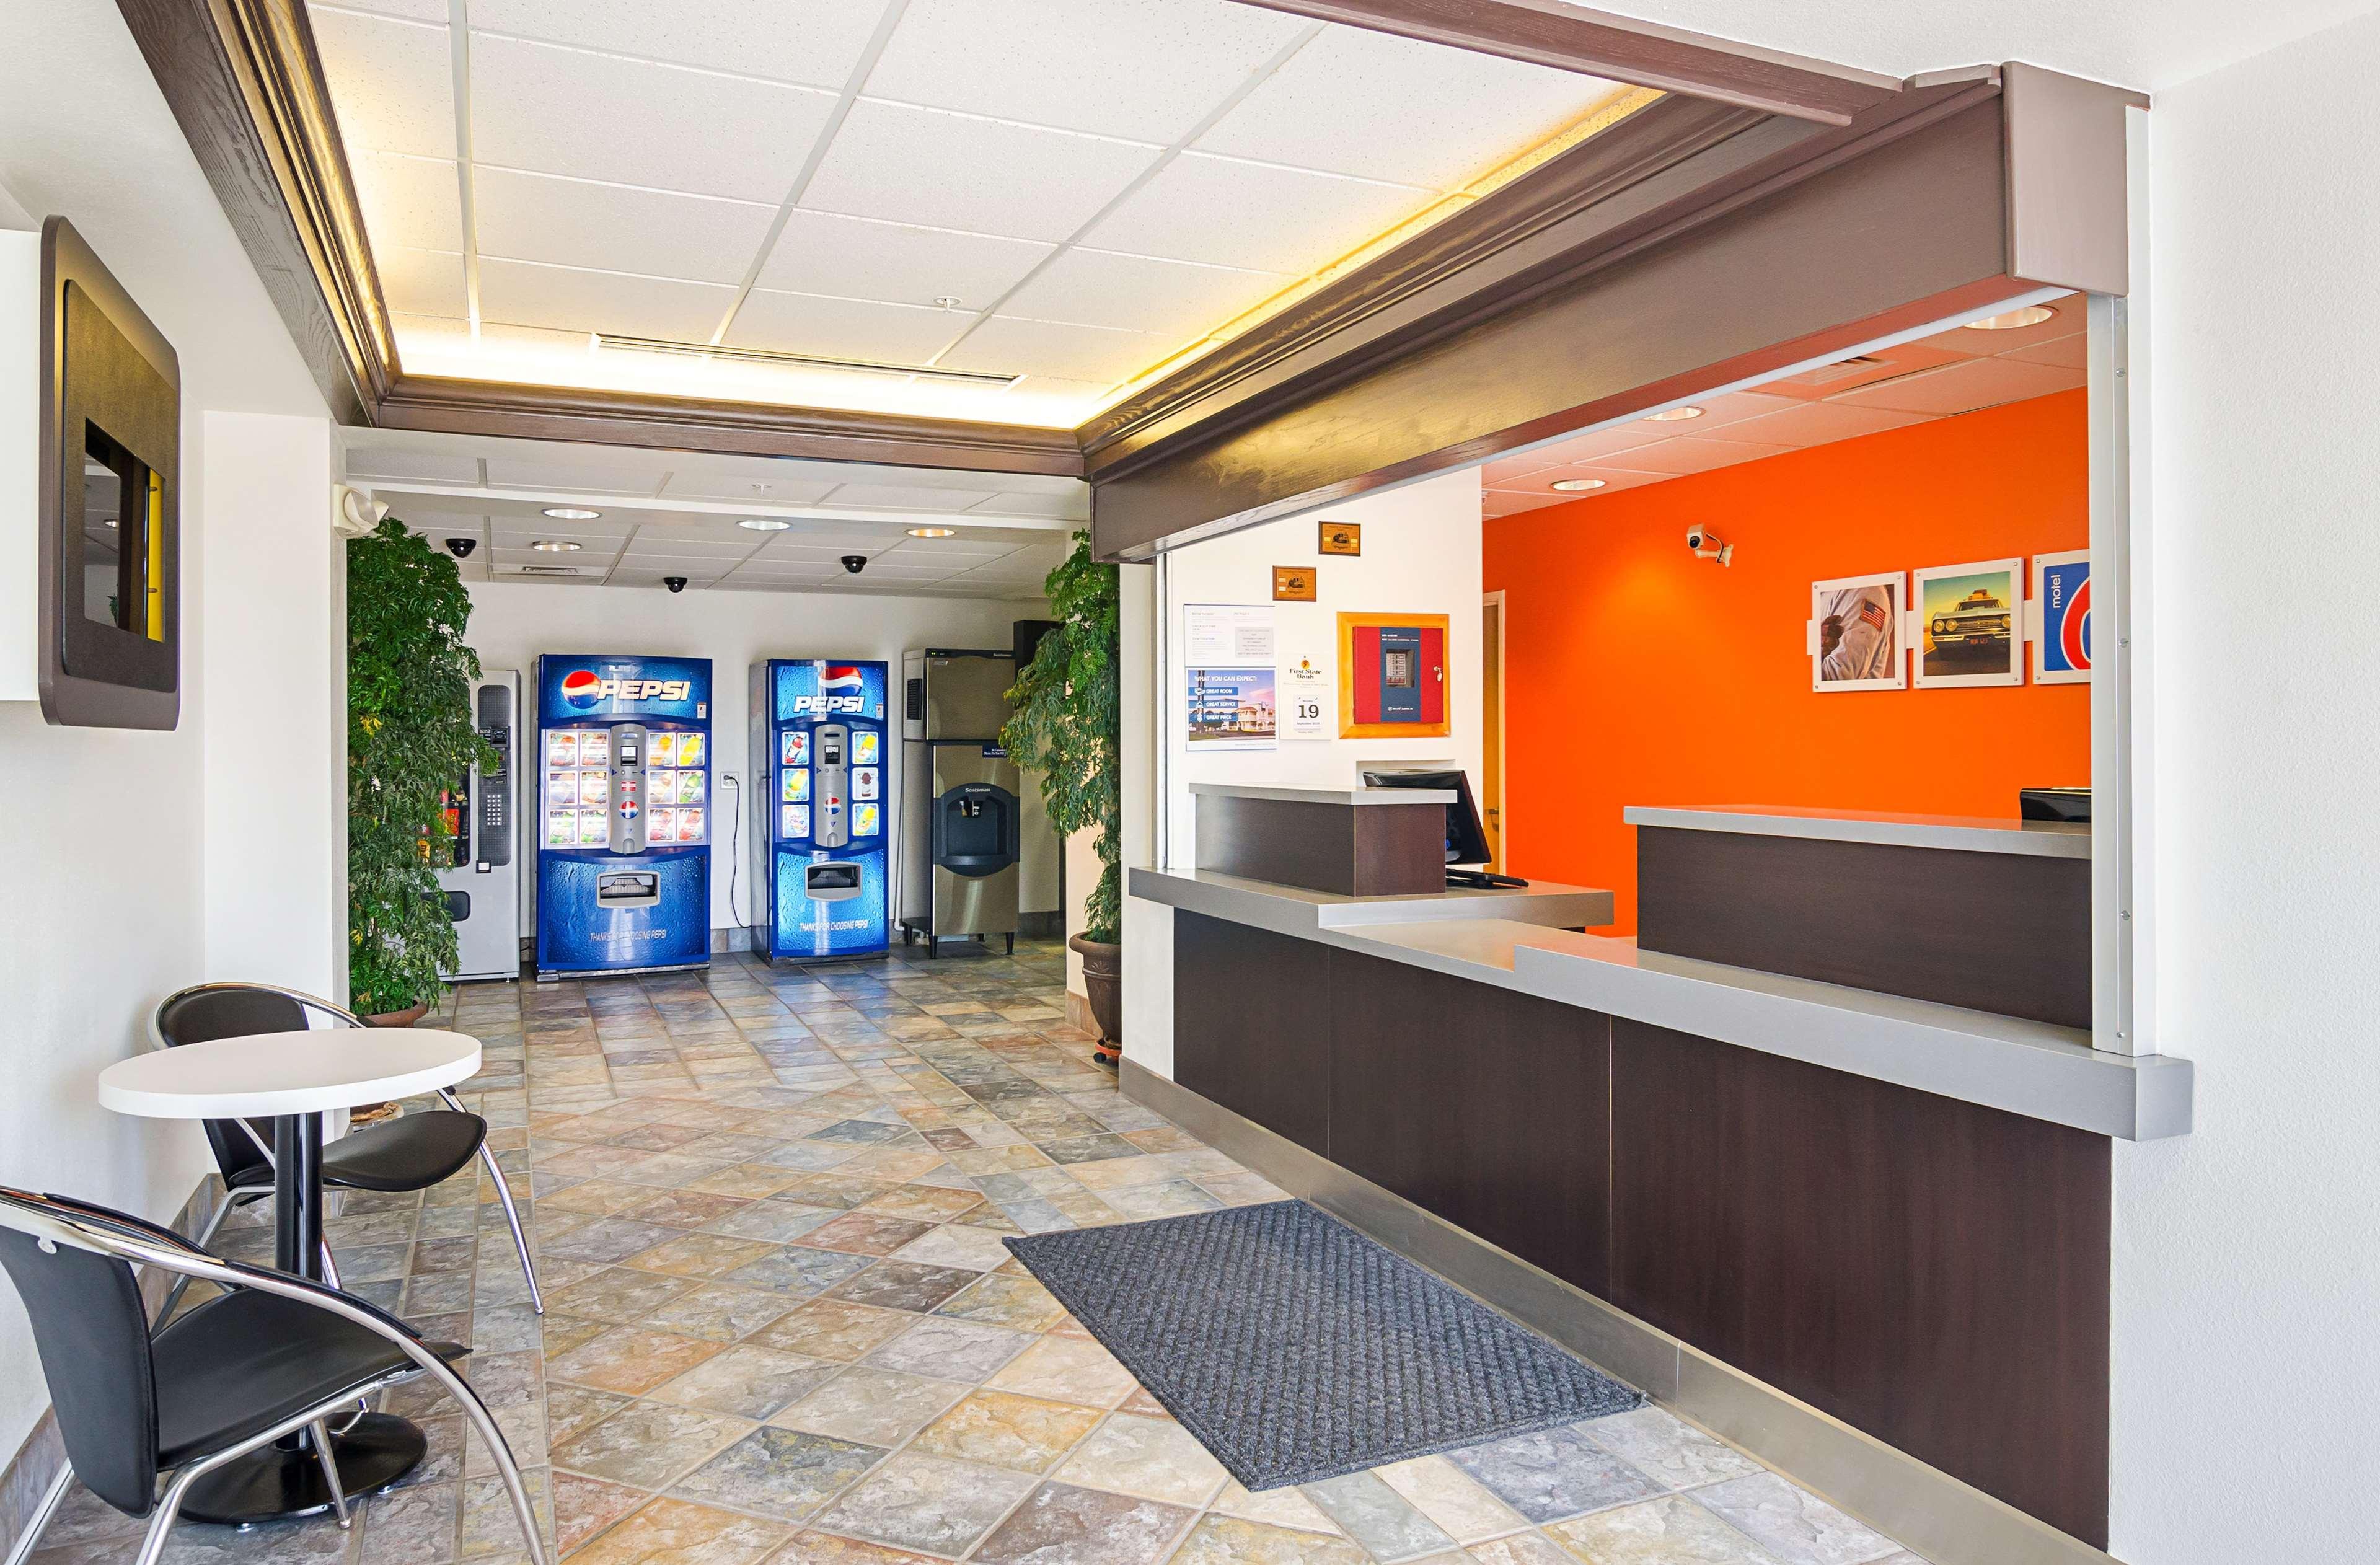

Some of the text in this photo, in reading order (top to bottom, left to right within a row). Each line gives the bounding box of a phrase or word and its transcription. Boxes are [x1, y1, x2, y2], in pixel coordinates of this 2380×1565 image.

[2050, 575, 2061, 609] motel
[597, 679, 692, 701] PEPSI
[793, 695, 865, 713] PEPSI
[1298, 704, 1319, 718] 19
[800, 922, 818, 932] THANKS
[830, 920, 855, 930] CHOOSING
[855, 919, 868, 929] PEPSI
[590, 932, 612, 942] THANKS
[651, 928, 667, 940] PEPSI
